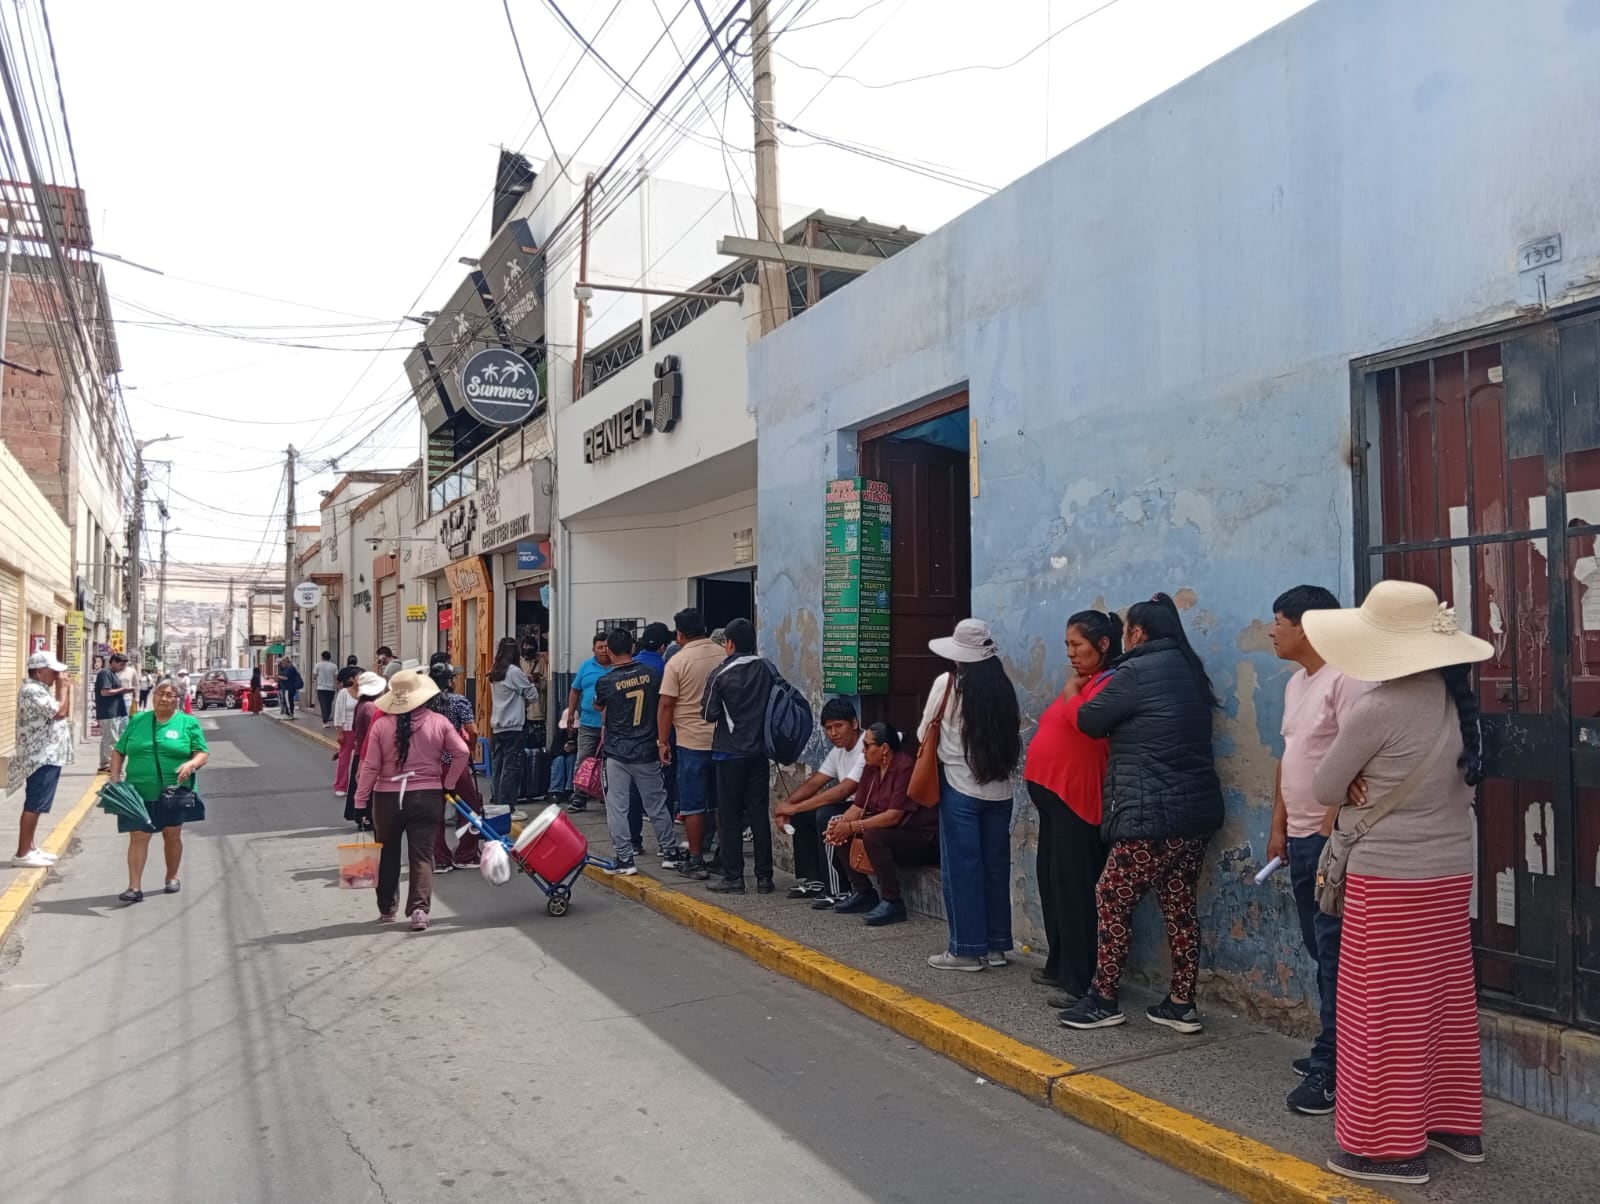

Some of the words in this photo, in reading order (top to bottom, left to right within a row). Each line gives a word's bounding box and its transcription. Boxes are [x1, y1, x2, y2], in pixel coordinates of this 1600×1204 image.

[466, 375, 535, 402] Summer
[583, 399, 653, 464] RENIEC
[862, 490, 891, 504] WILSON
[482, 521, 510, 550] CENTER
[509, 512, 530, 539] BANK
[615, 674, 650, 691] RONALDO
[626, 689, 645, 727] 7
